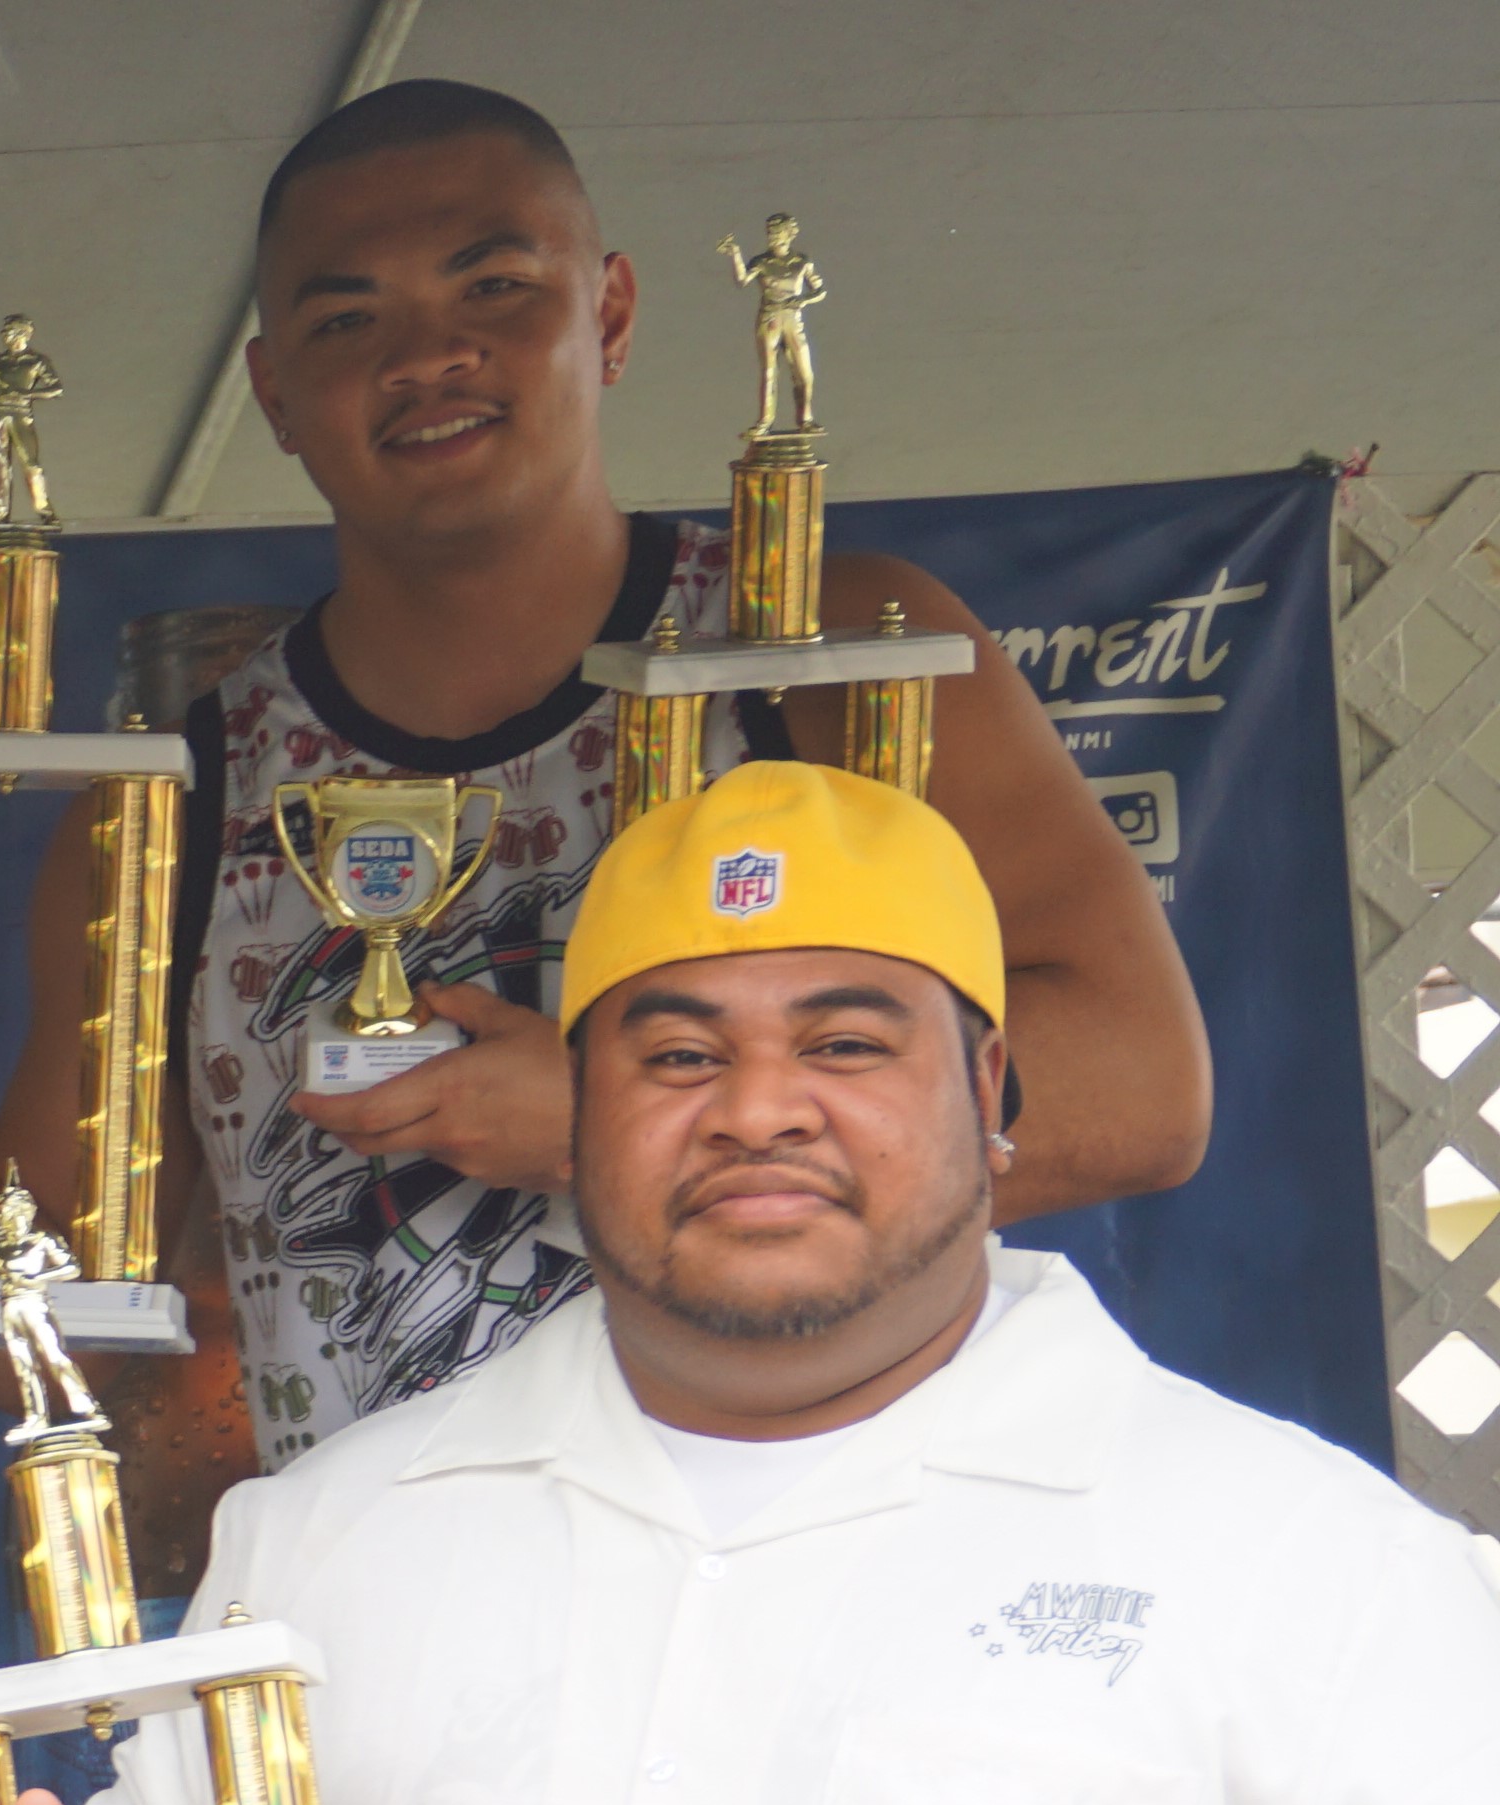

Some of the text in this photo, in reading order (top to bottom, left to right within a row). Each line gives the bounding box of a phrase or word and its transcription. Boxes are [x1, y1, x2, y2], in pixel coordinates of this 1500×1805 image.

[990, 568, 1268, 691] rrent
[1065, 731, 1112, 750] NMI
[351, 840, 409, 857] SEDA
[721, 877, 771, 908] NFL
